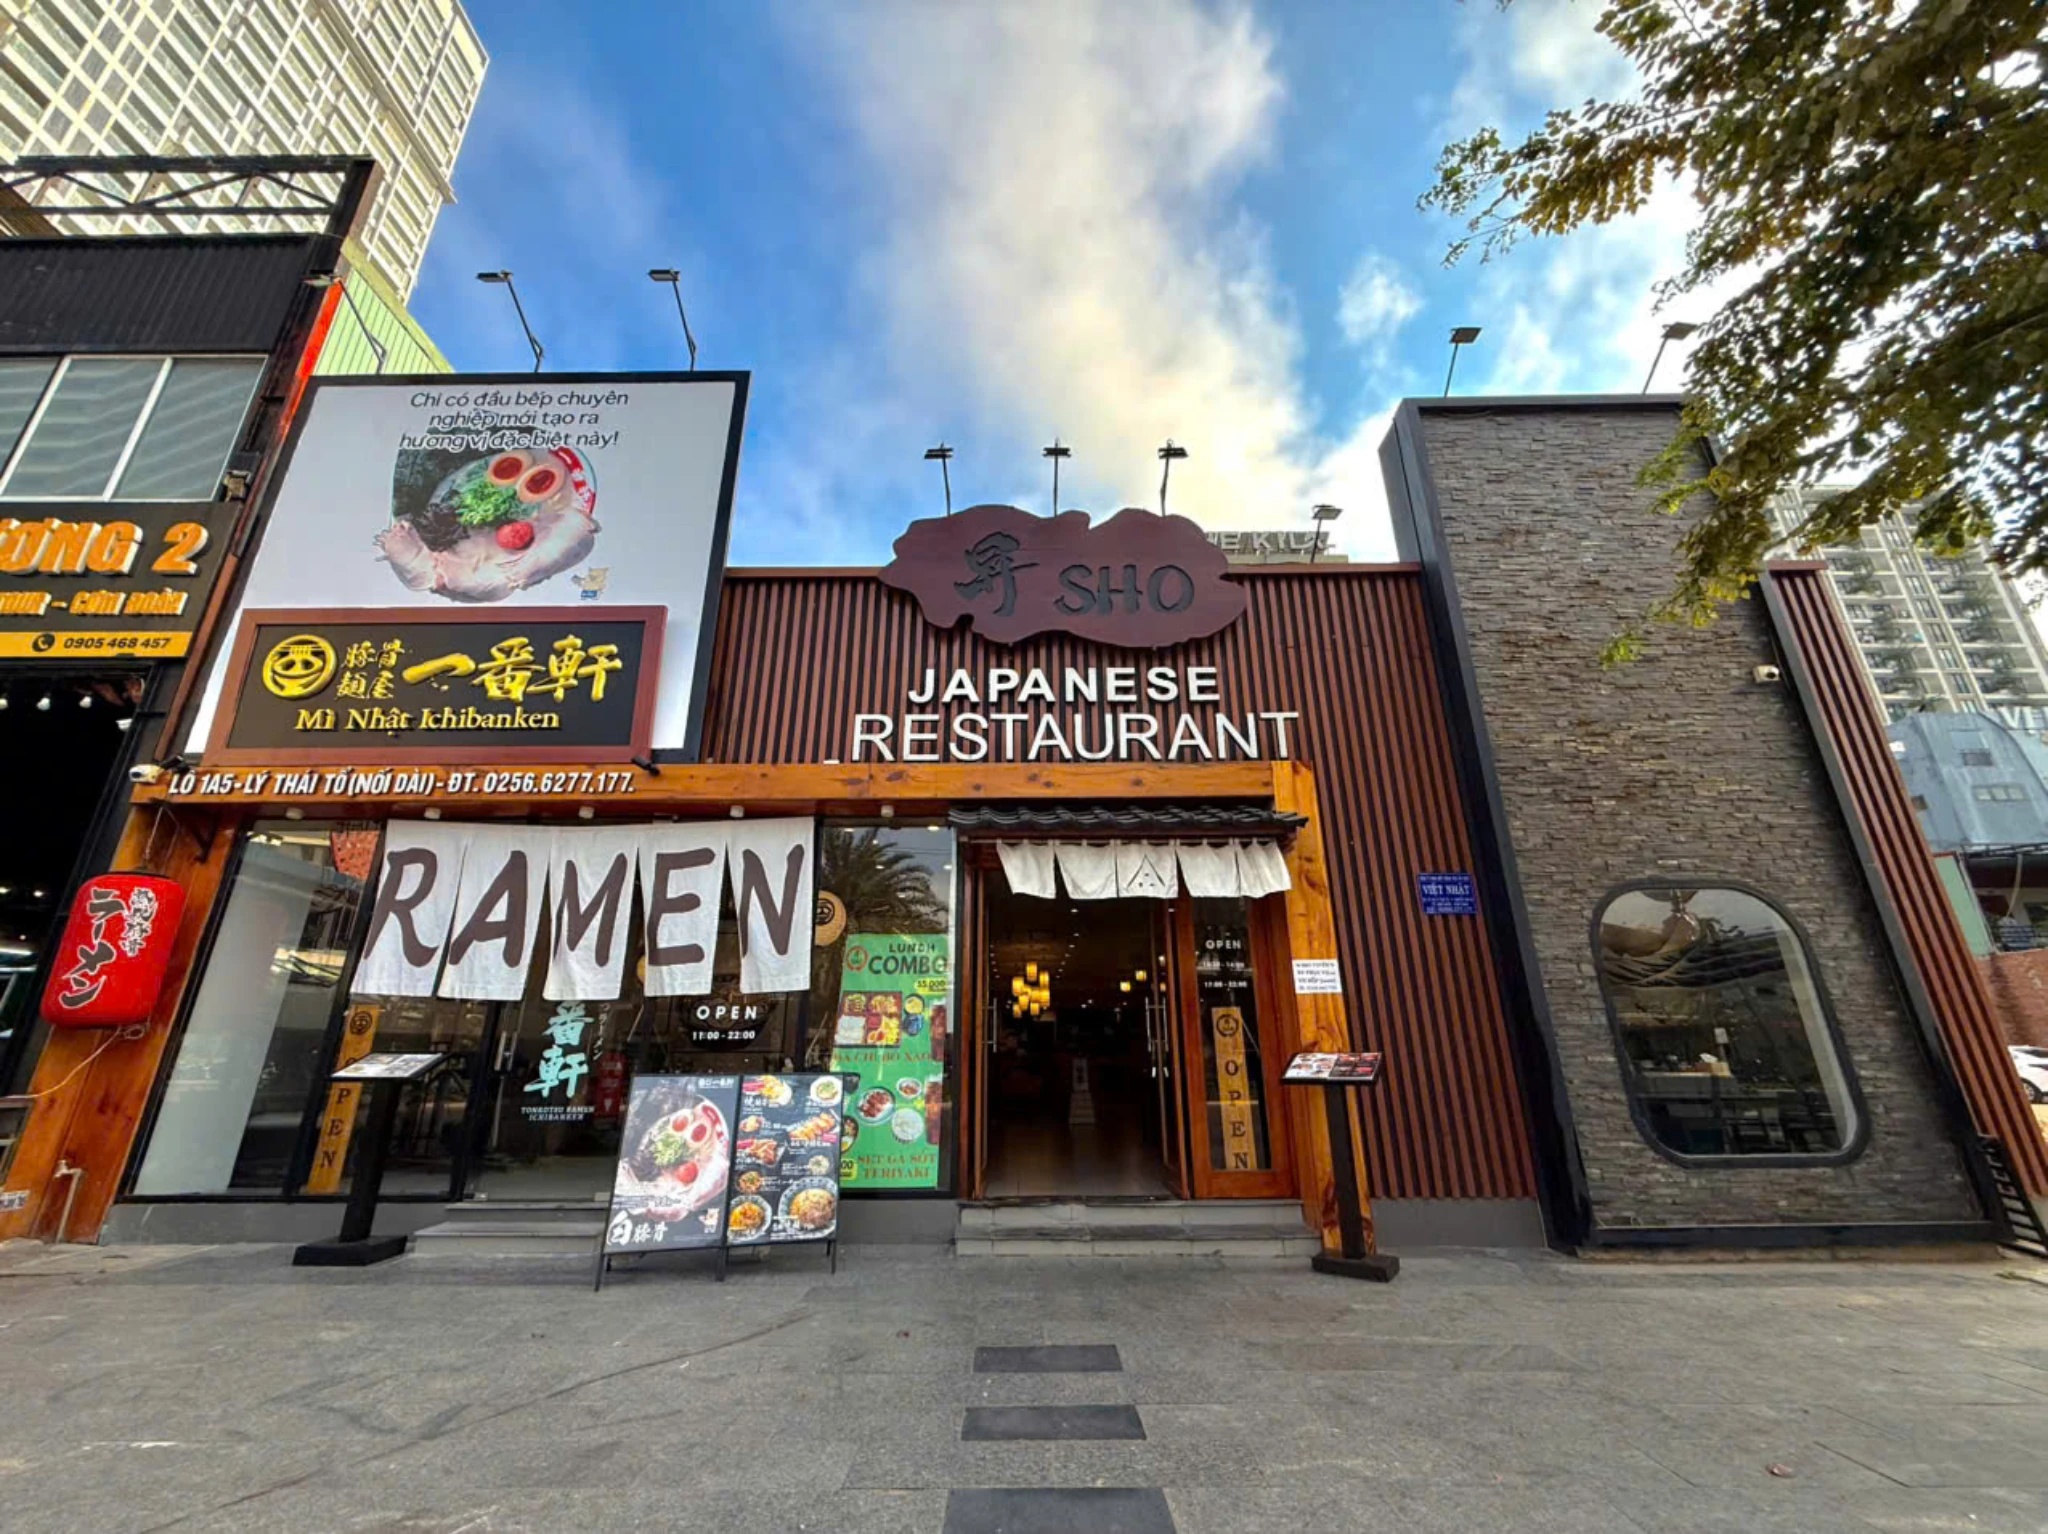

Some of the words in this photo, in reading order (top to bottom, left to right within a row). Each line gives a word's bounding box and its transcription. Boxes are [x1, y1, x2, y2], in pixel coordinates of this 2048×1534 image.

[444, 392, 469, 407] có
[515, 390, 553, 409] bếp
[557, 391, 629, 409] chuyên
[429, 410, 496, 429] nghiệp
[501, 411, 537, 426] mới
[541, 412, 575, 428] tạo
[578, 413, 600, 425] ra
[400, 433, 465, 450] hương
[468, 434, 490, 450] vị
[491, 430, 532, 449] đặc
[532, 432, 571, 449] biệt
[575, 431, 619, 449] này!
[152, 522, 209, 575] 2
[1053, 564, 1195, 616] SHO
[63, 638, 104, 649] 0905
[106, 638, 138, 649] 468
[140, 637, 171, 649] 457
[908, 666, 1221, 704] JAPANESE
[295, 706, 335, 731] Mì
[345, 706, 412, 736] Nhật
[418, 706, 560, 731] Ichibanken
[851, 711, 1300, 762] RESTAURANT
[168, 769, 196, 794] LÔ
[272, 769, 319, 794] THÁI
[363, 843, 805, 969] RAMEN
[59, 887, 128, 1009] ラーメン
[888, 943, 935, 953] LUNCH
[1204, 939, 1242, 950] OPEN
[868, 954, 949, 976] COMBO
[696, 1005, 757, 1020] OPEN
[1224, 1059, 1249, 1170] OPEN
